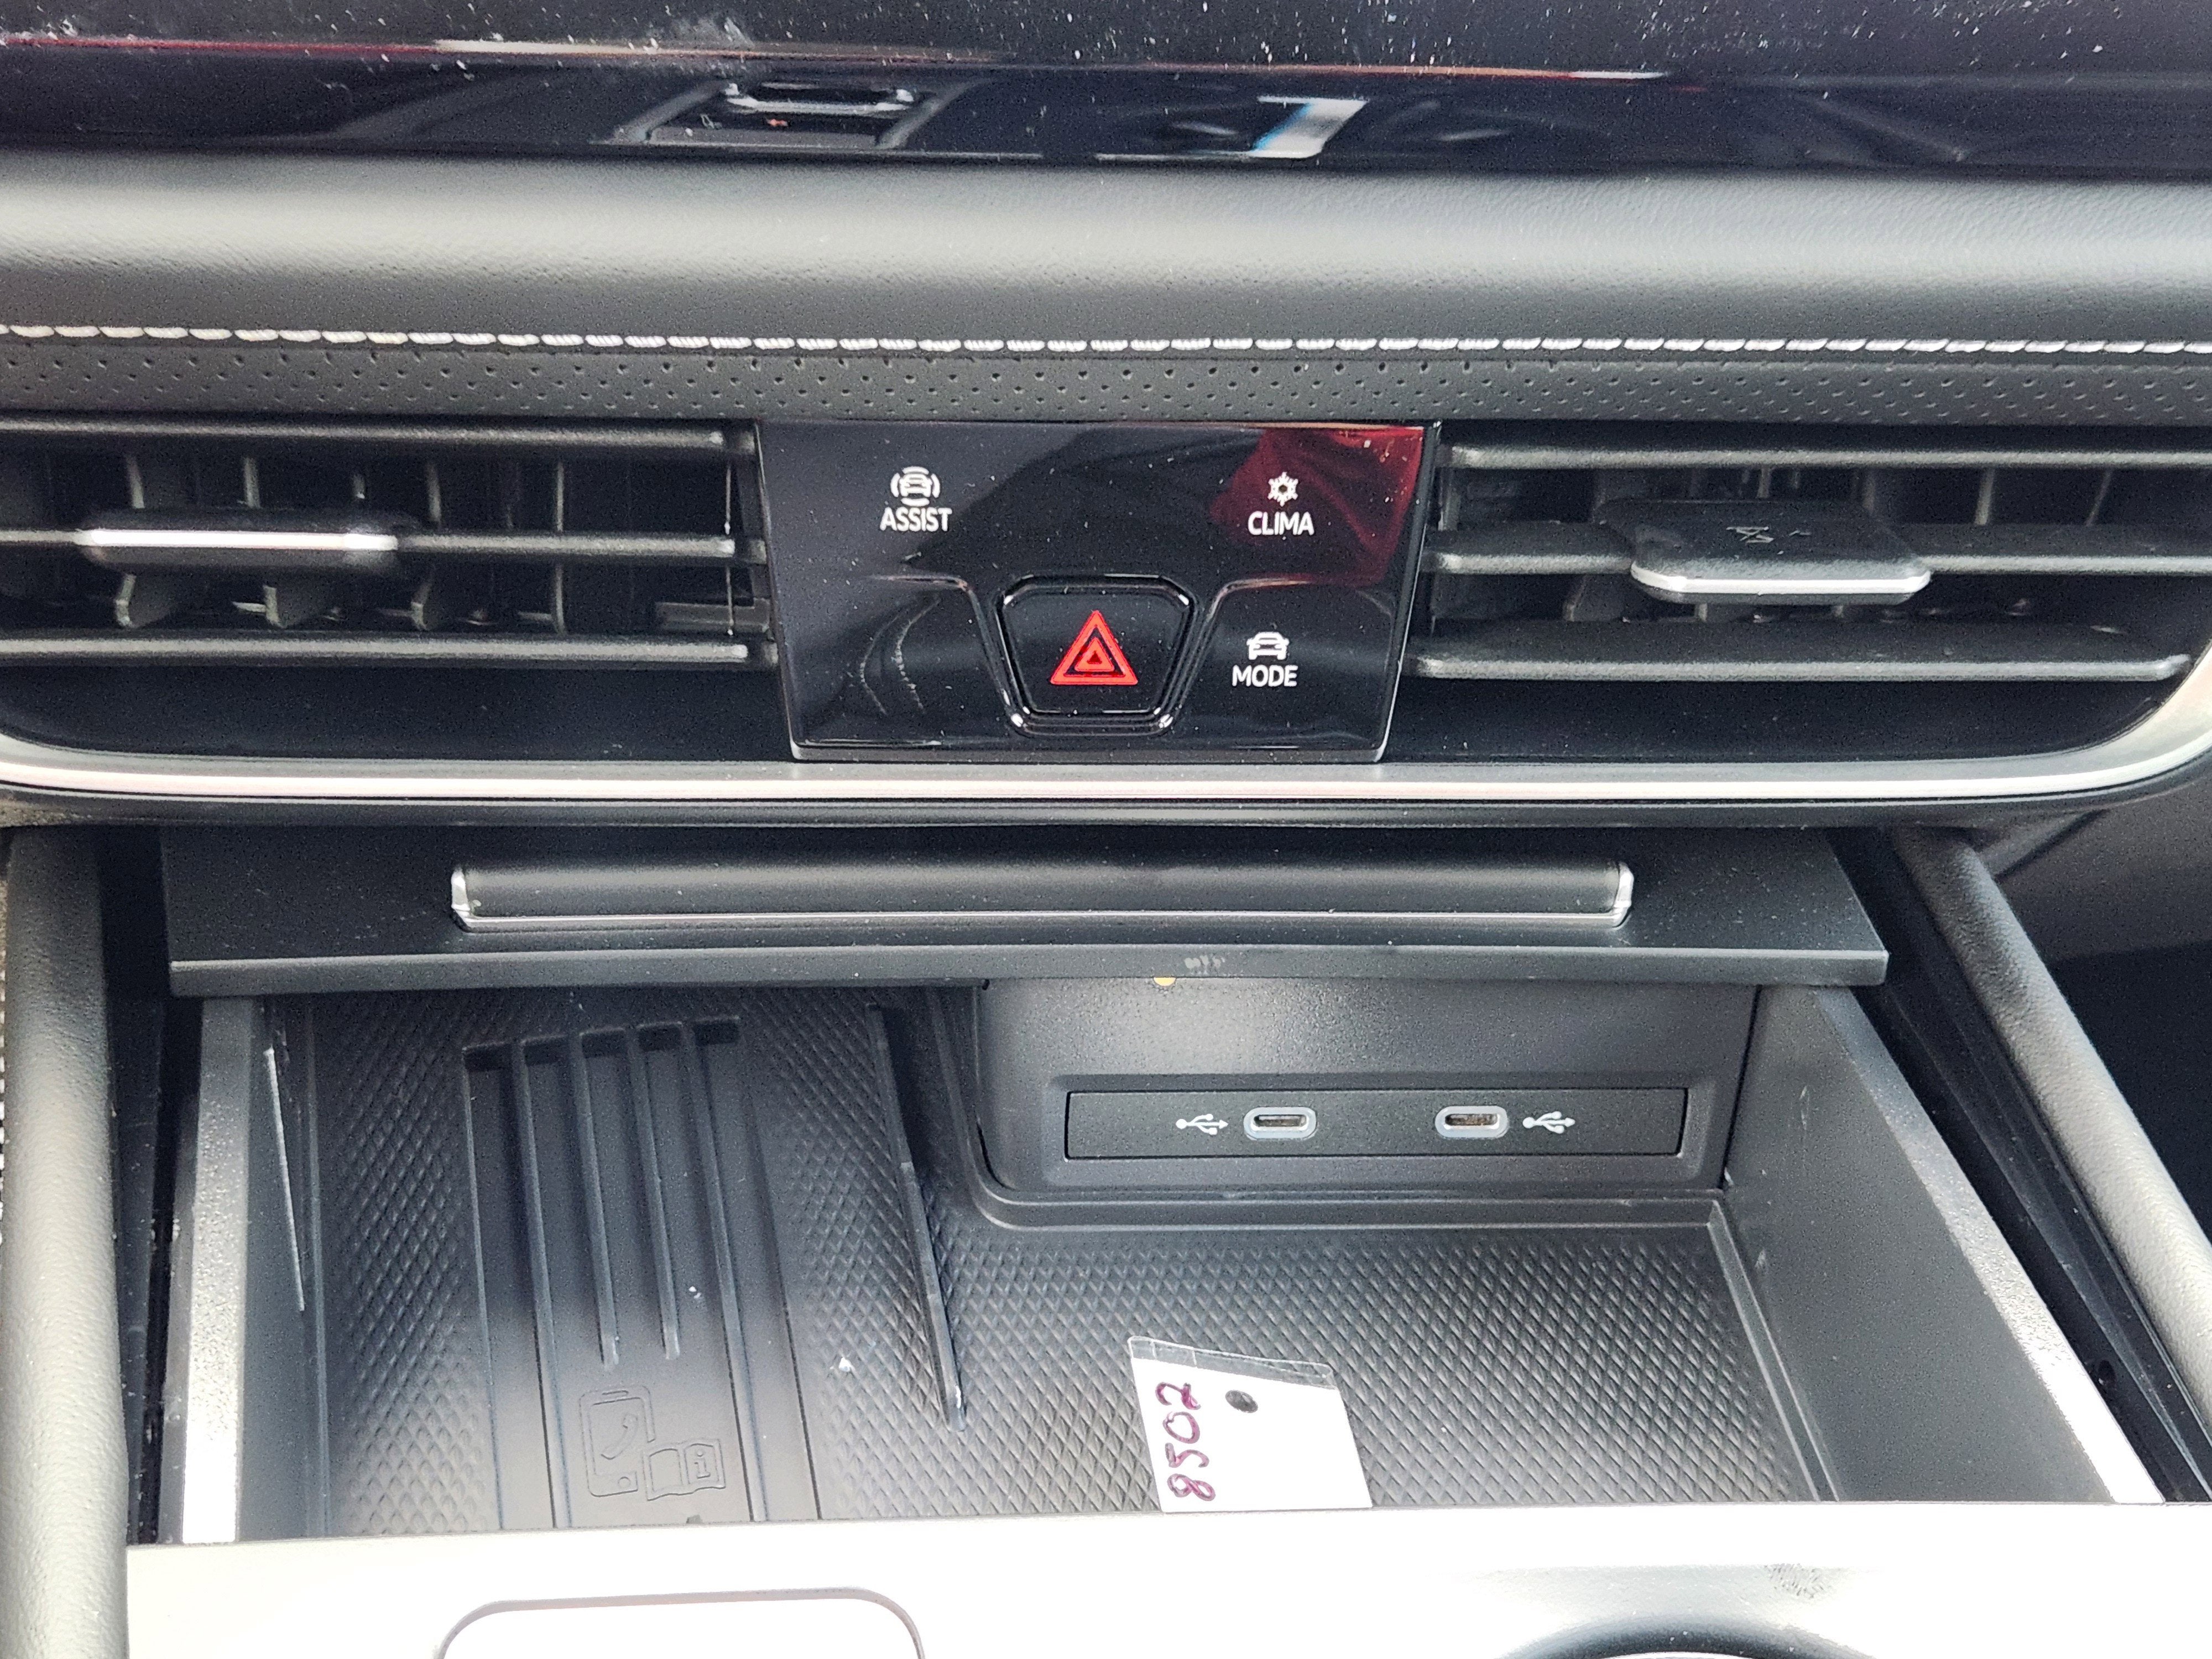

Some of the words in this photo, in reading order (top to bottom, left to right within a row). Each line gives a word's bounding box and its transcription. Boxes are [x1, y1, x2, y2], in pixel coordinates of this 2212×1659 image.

[880, 507, 953, 533] ASSIST
[1248, 510, 1314, 536] CLIMA
[1232, 664, 1298, 687] MODE
[1155, 1381, 1216, 1501] 8502
